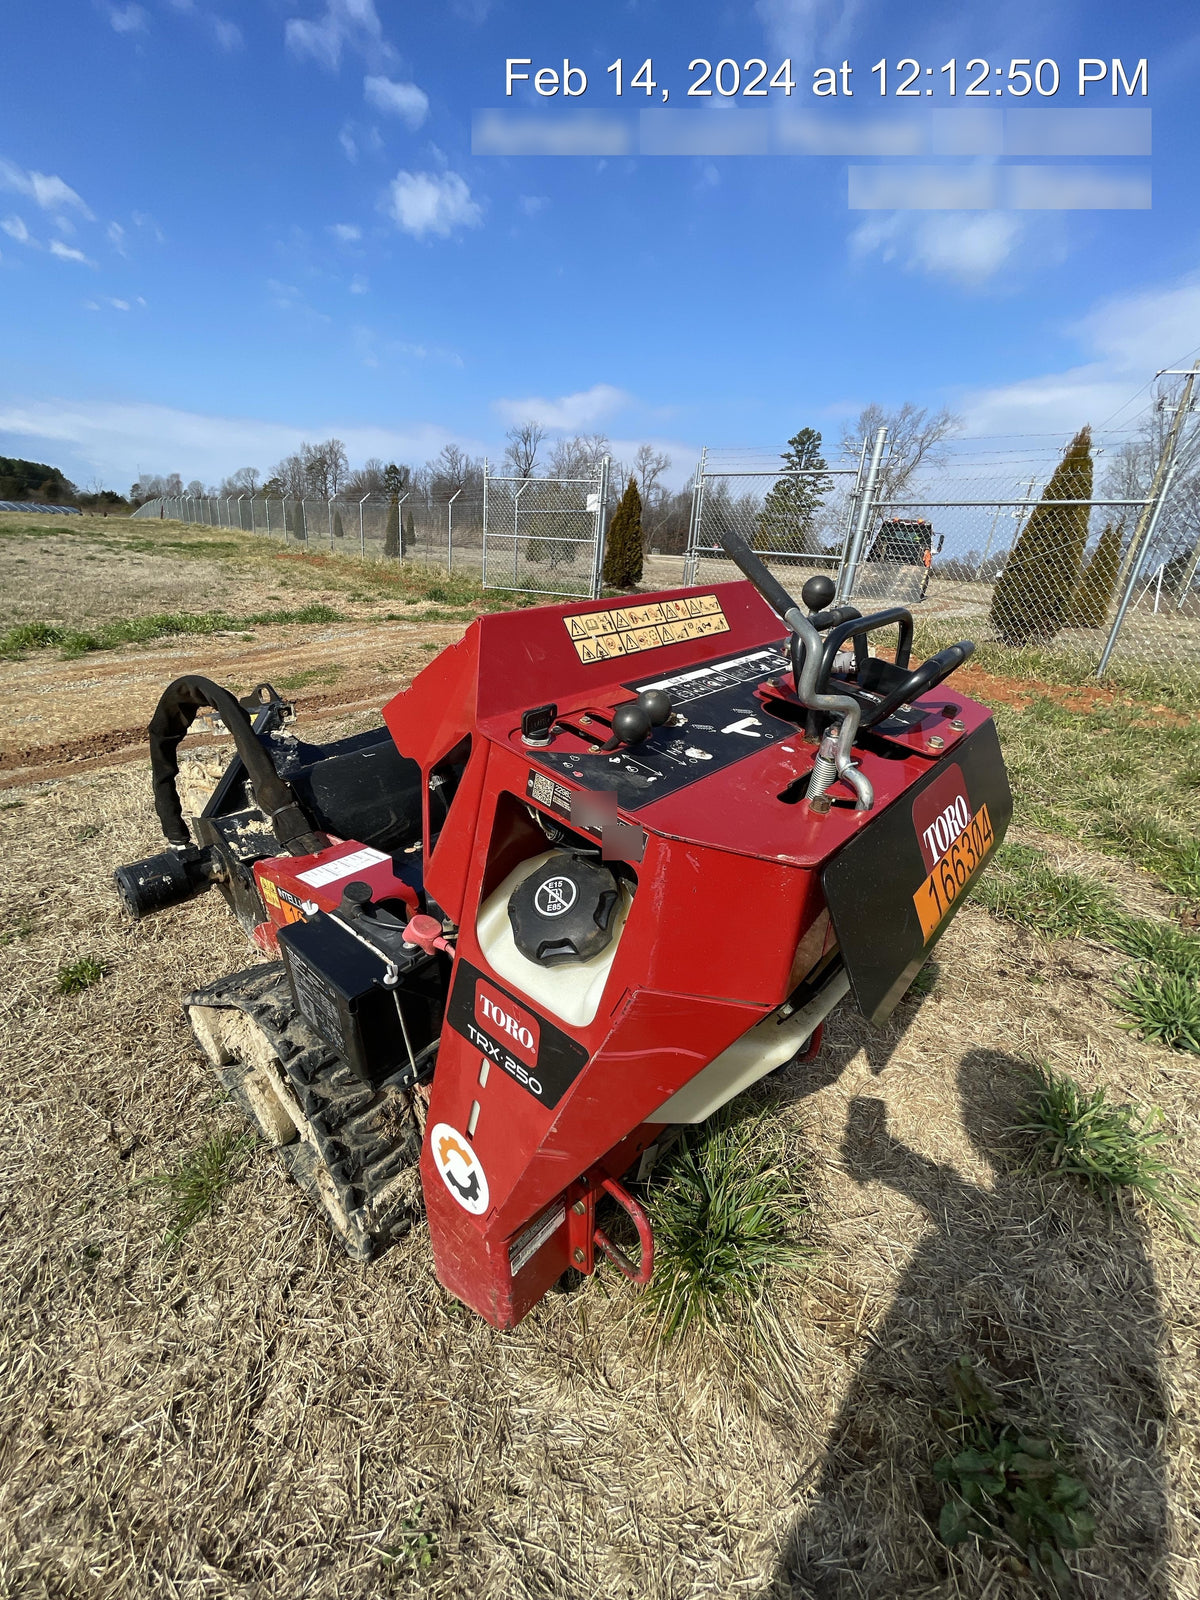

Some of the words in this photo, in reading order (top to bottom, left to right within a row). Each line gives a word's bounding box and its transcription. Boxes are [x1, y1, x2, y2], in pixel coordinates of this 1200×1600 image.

[923, 794, 968, 866] TORO
[548, 881, 563, 889] E15
[928, 806, 993, 920] 166304
[546, 903, 562, 912] E85
[480, 994, 534, 1049] TORO
